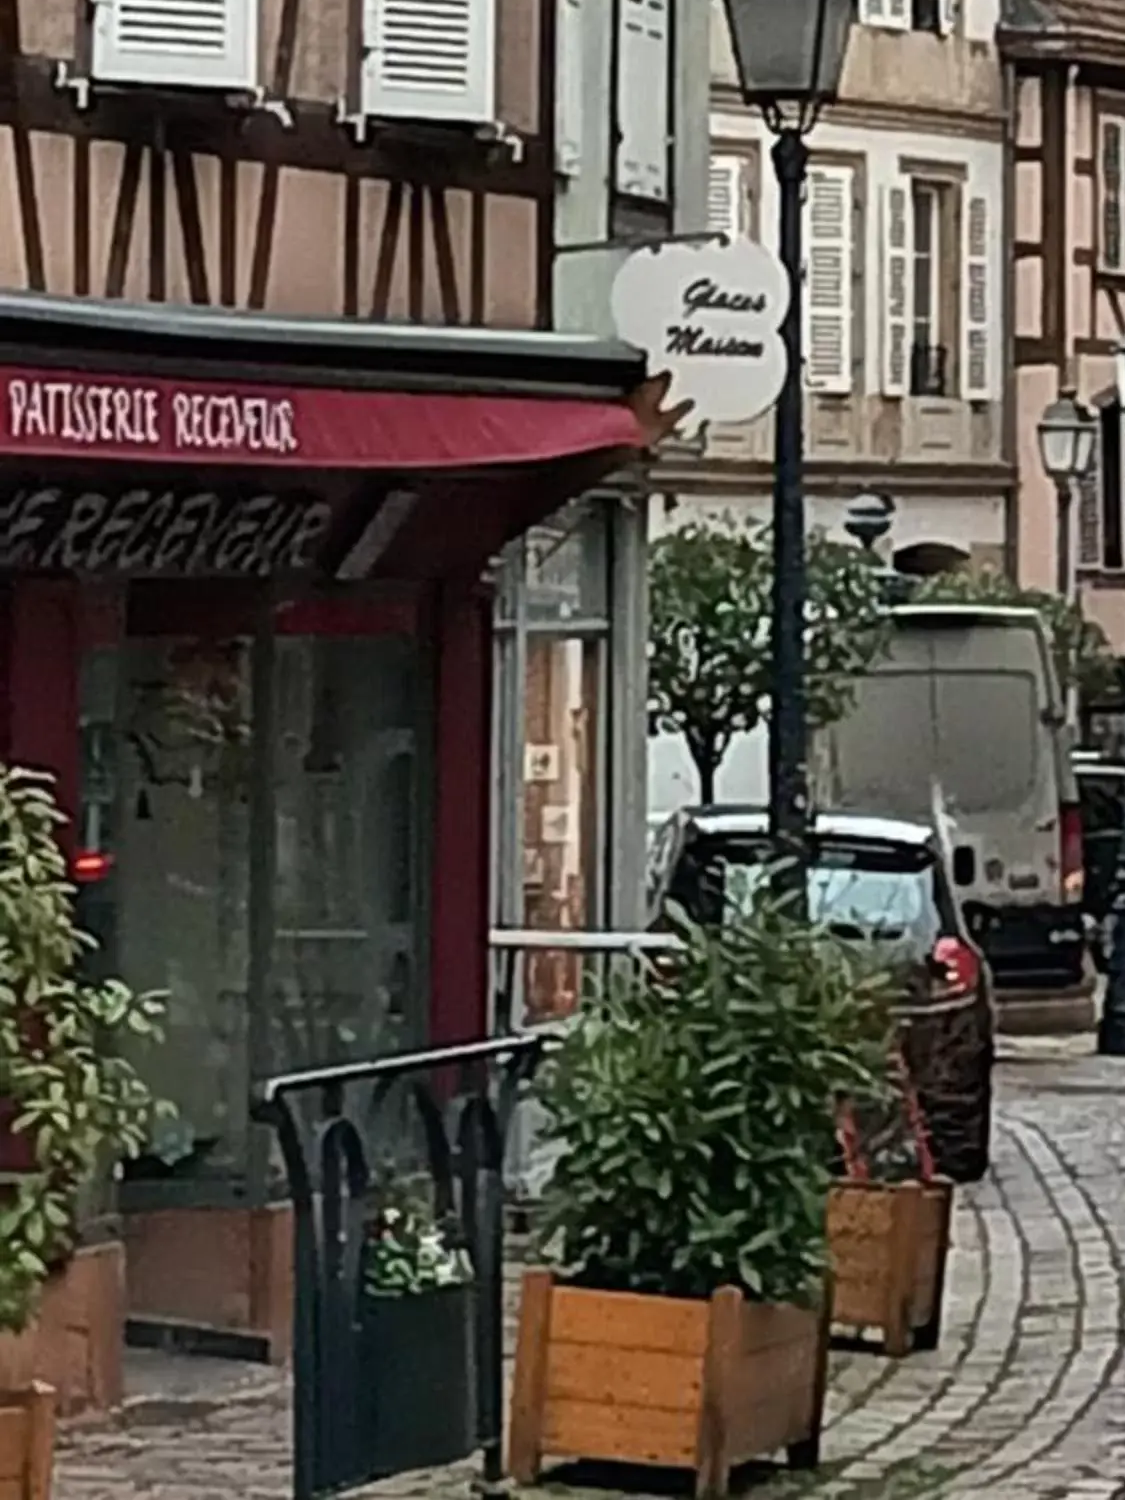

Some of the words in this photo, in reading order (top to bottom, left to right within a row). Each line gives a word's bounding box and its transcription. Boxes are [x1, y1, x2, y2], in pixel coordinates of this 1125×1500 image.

[682, 278, 766, 318] Glaces
[665, 325, 764, 358] Maison
[8, 379, 160, 443] PATISSERIE
[172, 392, 298, 452] RECEVEUR
